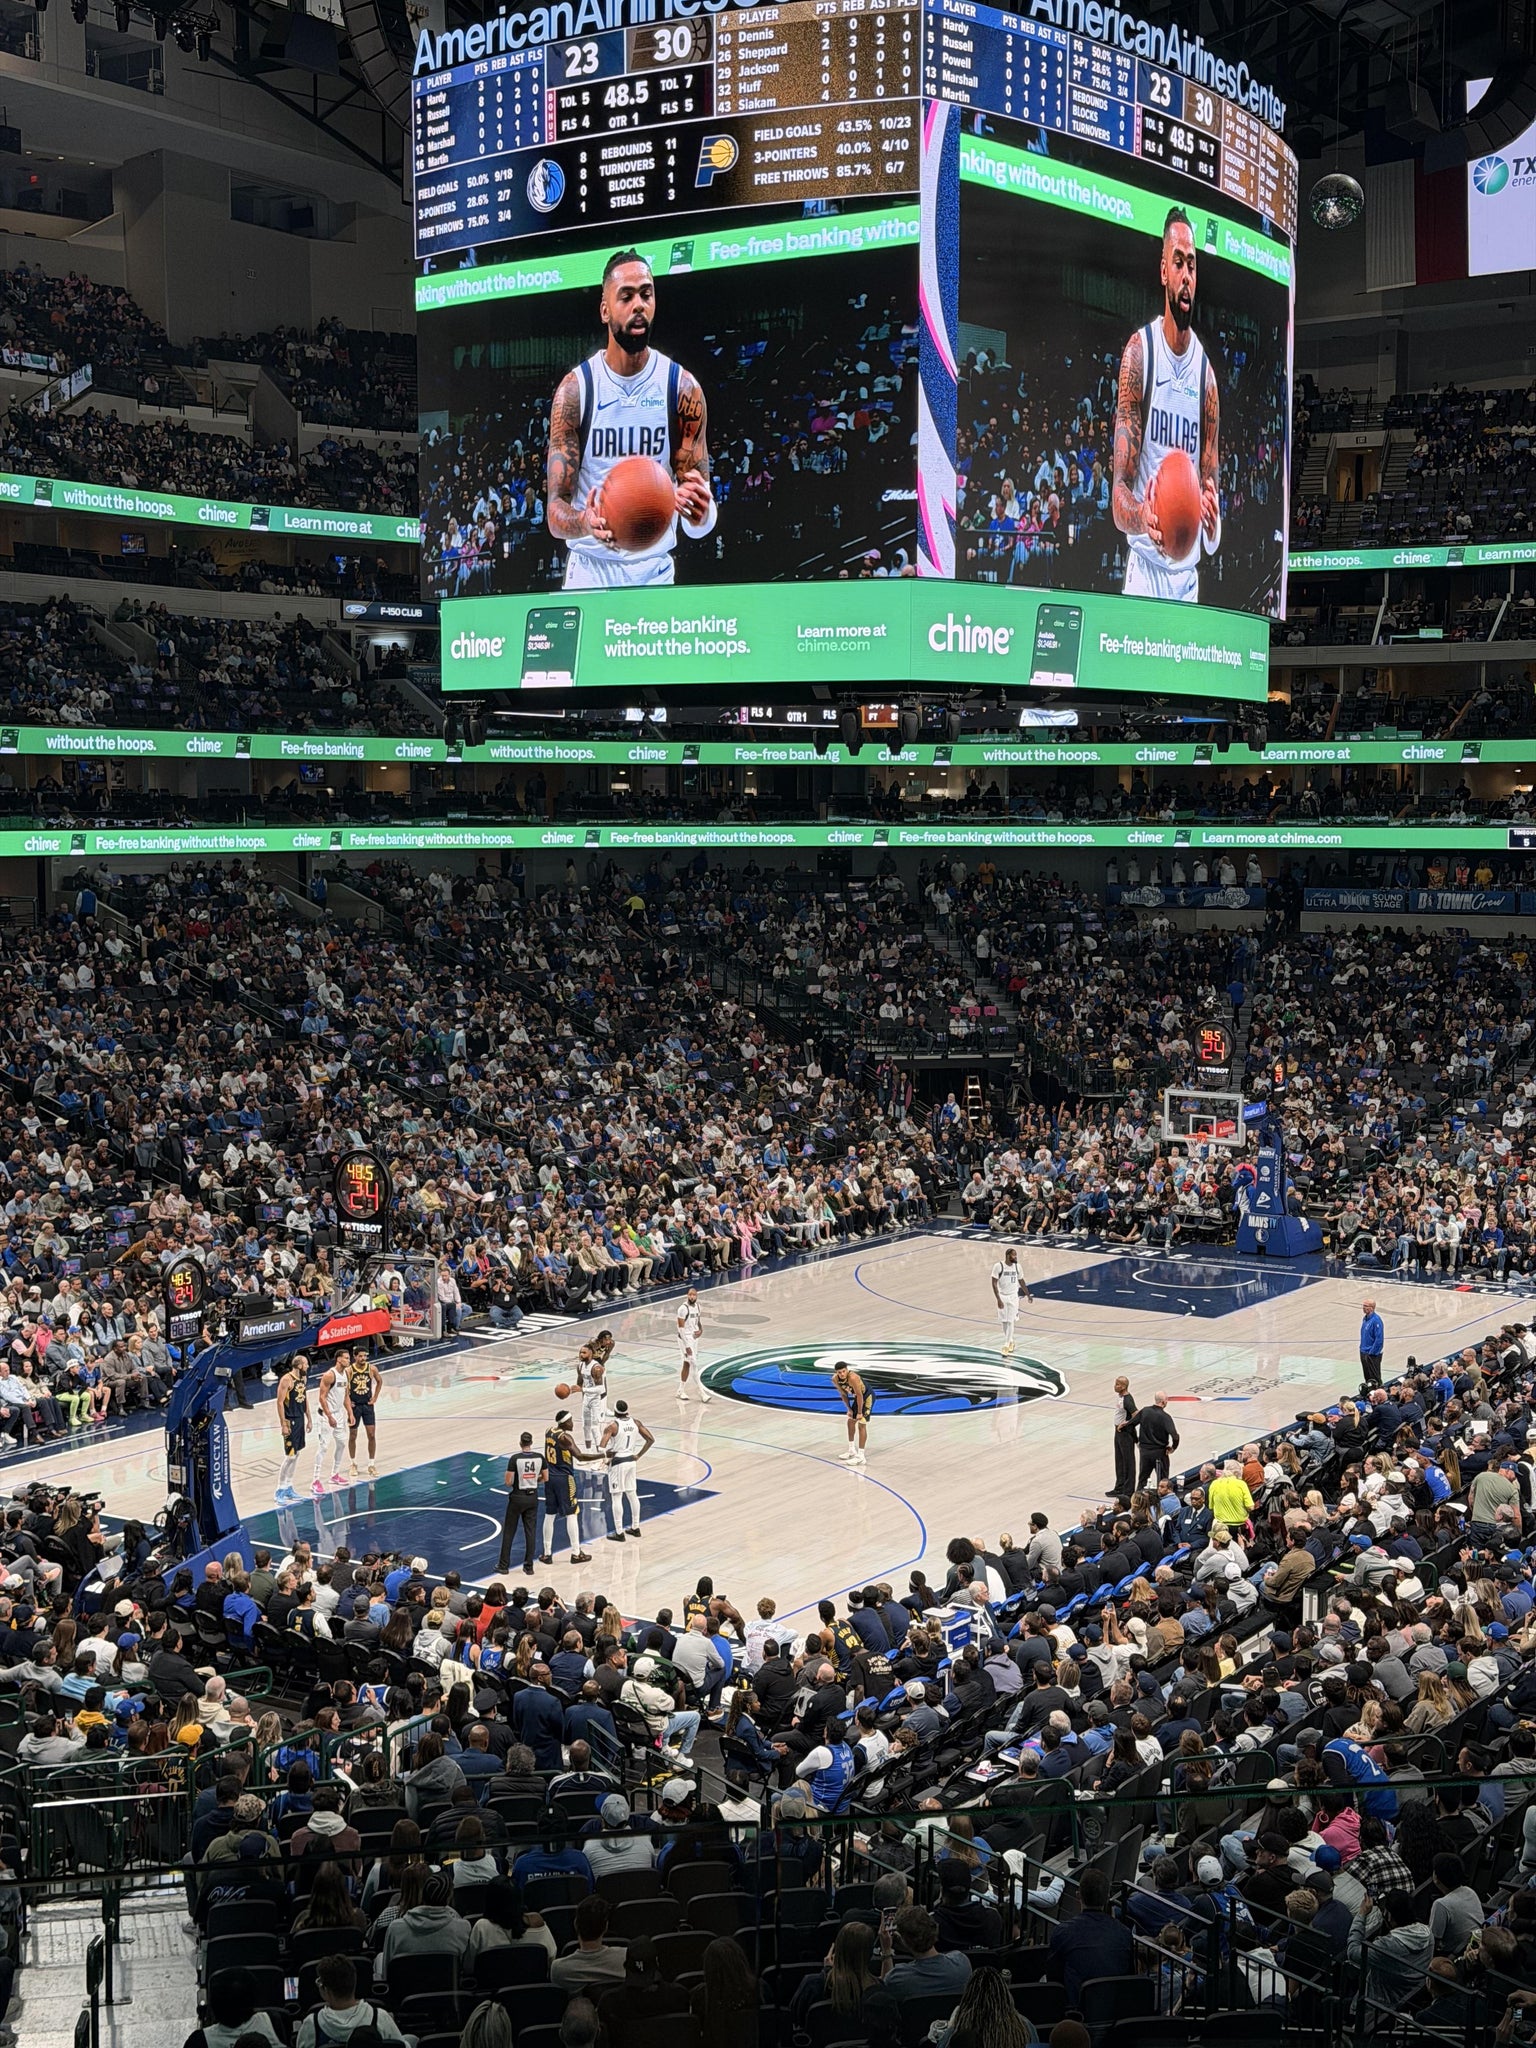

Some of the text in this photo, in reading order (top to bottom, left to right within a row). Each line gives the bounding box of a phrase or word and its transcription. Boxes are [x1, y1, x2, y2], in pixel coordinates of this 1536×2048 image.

[737, 2, 836, 27] PLAYER PTS
[718, 27, 774, 45] 10 Dennis
[1003, 15, 1067, 45] PTS REB AST FLS
[653, 26, 692, 61] 30
[718, 42, 788, 63] 26 Sheppard
[427, 49, 543, 89] PLAYER REB AST FLS
[565, 42, 599, 78] 23
[718, 63, 779, 79] 29 Jackson
[604, 80, 649, 108] 48.5
[660, 78, 679, 91] TOL
[718, 80, 762, 96] 32 Huff
[1150, 72, 1171, 107] 23
[427, 92, 447, 106] Hardy
[560, 95, 577, 108] TOL
[661, 101, 679, 115] FLS
[718, 101, 731, 113] 43
[1195, 90, 1215, 126] 30
[427, 105, 450, 122] Russell
[427, 121, 449, 137] Powell
[561, 118, 577, 131] FLS
[754, 116, 911, 142] FIELD GOALS 43.5% 10/23
[427, 135, 455, 152] Marshall
[1170, 123, 1195, 154] 48.5
[601, 141, 653, 160] REBOUNDS
[754, 138, 909, 163] 3-POINTERS 40.0% 4/10
[426, 153, 451, 170] Martin
[599, 158, 655, 177] TURNOVERS
[754, 161, 905, 185] FREE THROWS 85.7% 6/7
[418, 168, 513, 200] FIELD GOALS 50.0% 9/18
[608, 176, 645, 192] BLOCKS
[418, 194, 489, 220] 3-POINTERS 28.6%
[610, 192, 644, 208] STEALS
[419, 214, 489, 240] FREE THROWS 75.0%
[786, 222, 863, 257] banking
[640, 397, 665, 408] chime
[1151, 406, 1199, 454] DALLAS
[592, 426, 666, 458] DALLAS
[63, 489, 113, 509] without
[113, 494, 134, 511] the
[135, 496, 176, 519] hoops.
[284, 513, 322, 530] Learn
[323, 520, 358, 533] more
[1303, 549, 1511, 569] the hoops. Learn
[604, 637, 871, 658] without the hoops. chime.com
[605, 617, 668, 636] Fee-free
[671, 615, 737, 636] banking
[797, 625, 834, 638] Learn
[836, 626, 871, 637] more
[873, 624, 887, 636] at
[1100, 633, 1144, 655] Fee-free
[1144, 634, 1182, 664] banking
[46, 734, 94, 750] without
[95, 735, 116, 750] the
[117, 735, 156, 753] hoops.
[281, 740, 324, 755] Fee-free
[324, 741, 365, 759] banking
[490, 745, 533, 758] without
[534, 746, 553, 758] the
[555, 746, 596, 762] hoops.
[735, 748, 787, 760] Fee-free
[983, 749, 1033, 761] without
[1034, 749, 1056, 761] the
[1057, 749, 1101, 763] hoops.
[1300, 750, 1335, 759] more
[96, 836, 139, 850] Fee-free
[138, 836, 181, 853] banking
[181, 836, 218, 848] without
[219, 835, 235, 848] the
[236, 835, 269, 851] hoops.
[899, 831, 946, 842] Fee-free
[945, 831, 993, 846] banking
[993, 831, 1034, 843] without
[1037, 832, 1056, 842] the
[1057, 832, 1095, 845] hoops.
[1202, 832, 1235, 843] Learn
[1236, 835, 1267, 843] more
[1280, 832, 1342, 844] chime.com
[1306, 898, 1337, 907] ULTRA
[1201, 1041, 1225, 1061] 24
[1206, 1066, 1229, 1075] TISSOT
[347, 1163, 374, 1182] 48.5
[350, 1180, 379, 1212] 24
[351, 1222, 383, 1234] TISSOT
[171, 1272, 193, 1288] 48.5
[175, 1287, 194, 1305] 24
[179, 1310, 203, 1322] TISSOT
[242, 1319, 286, 1337] American
[213, 1424, 221, 1491] CHOCTAW
[524, 1461, 536, 1473] 54
